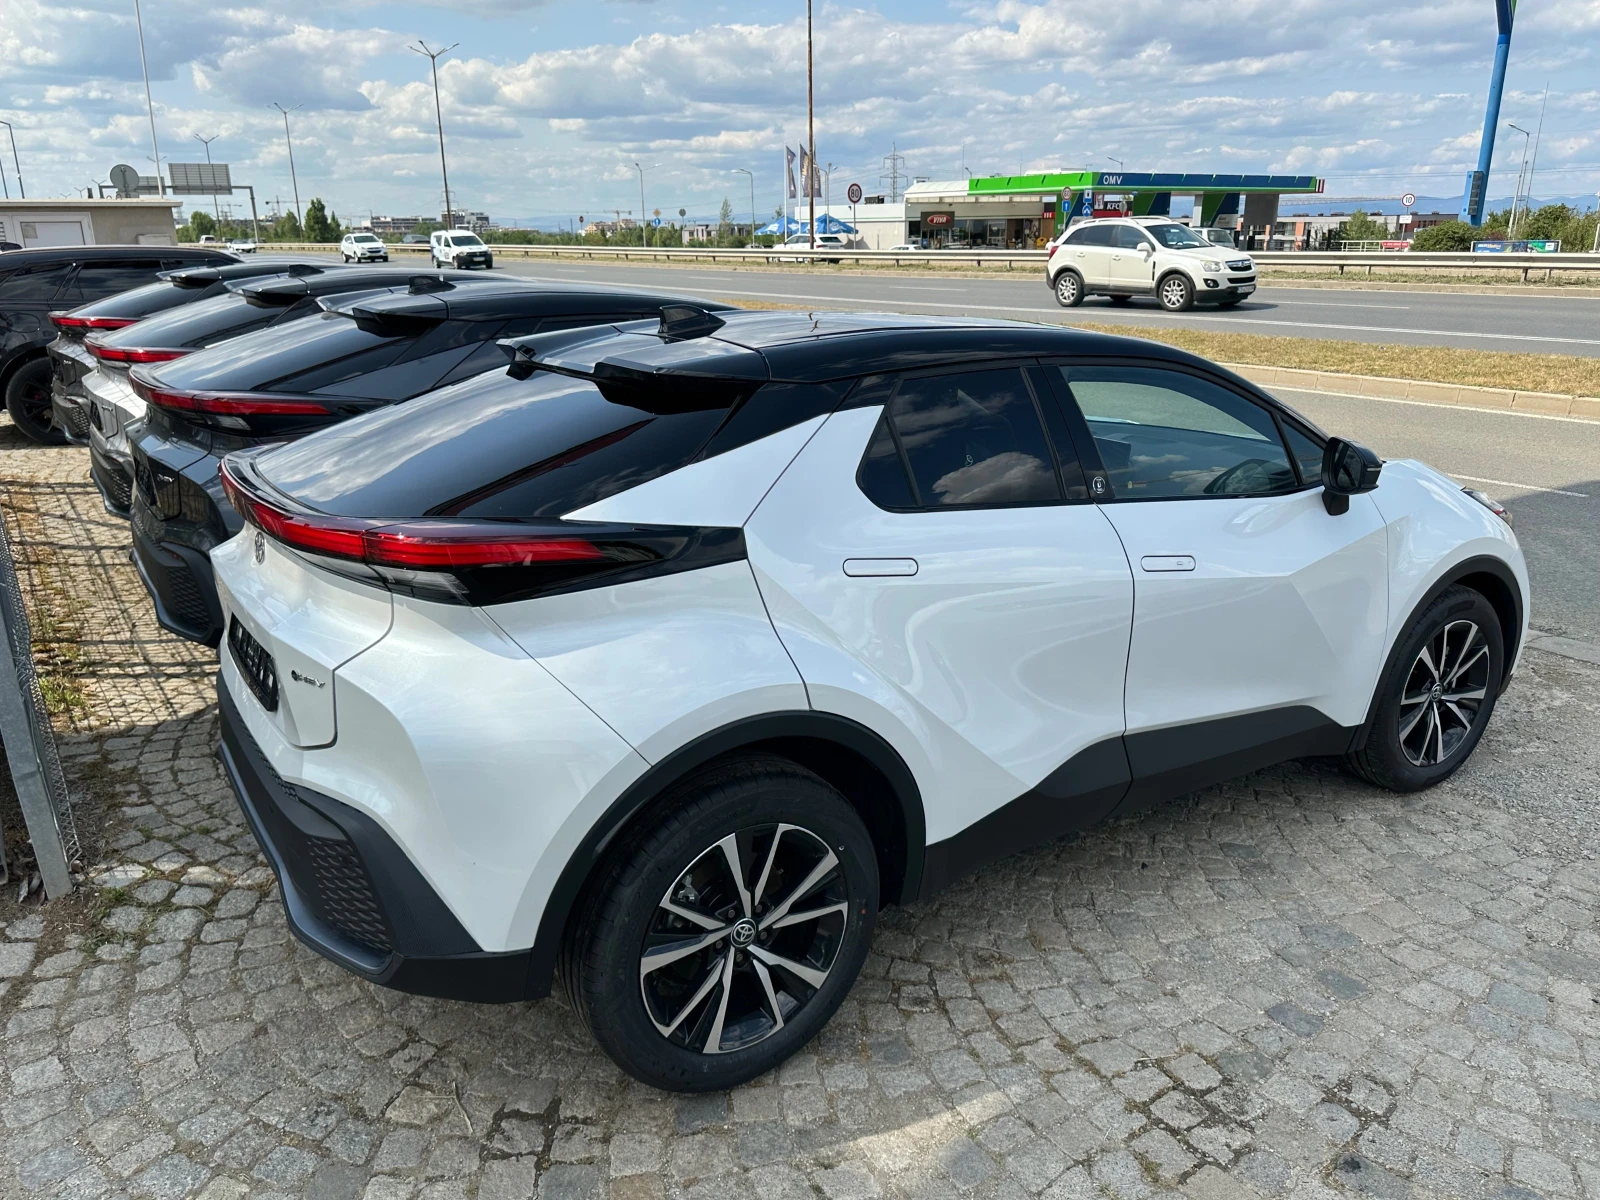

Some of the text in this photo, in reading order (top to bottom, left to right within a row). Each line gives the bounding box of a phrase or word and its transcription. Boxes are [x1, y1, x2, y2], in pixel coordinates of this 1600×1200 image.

[1103, 175, 1123, 184] OMV
[850, 188, 859, 198] 80
[933, 216, 947, 224] VIVA
